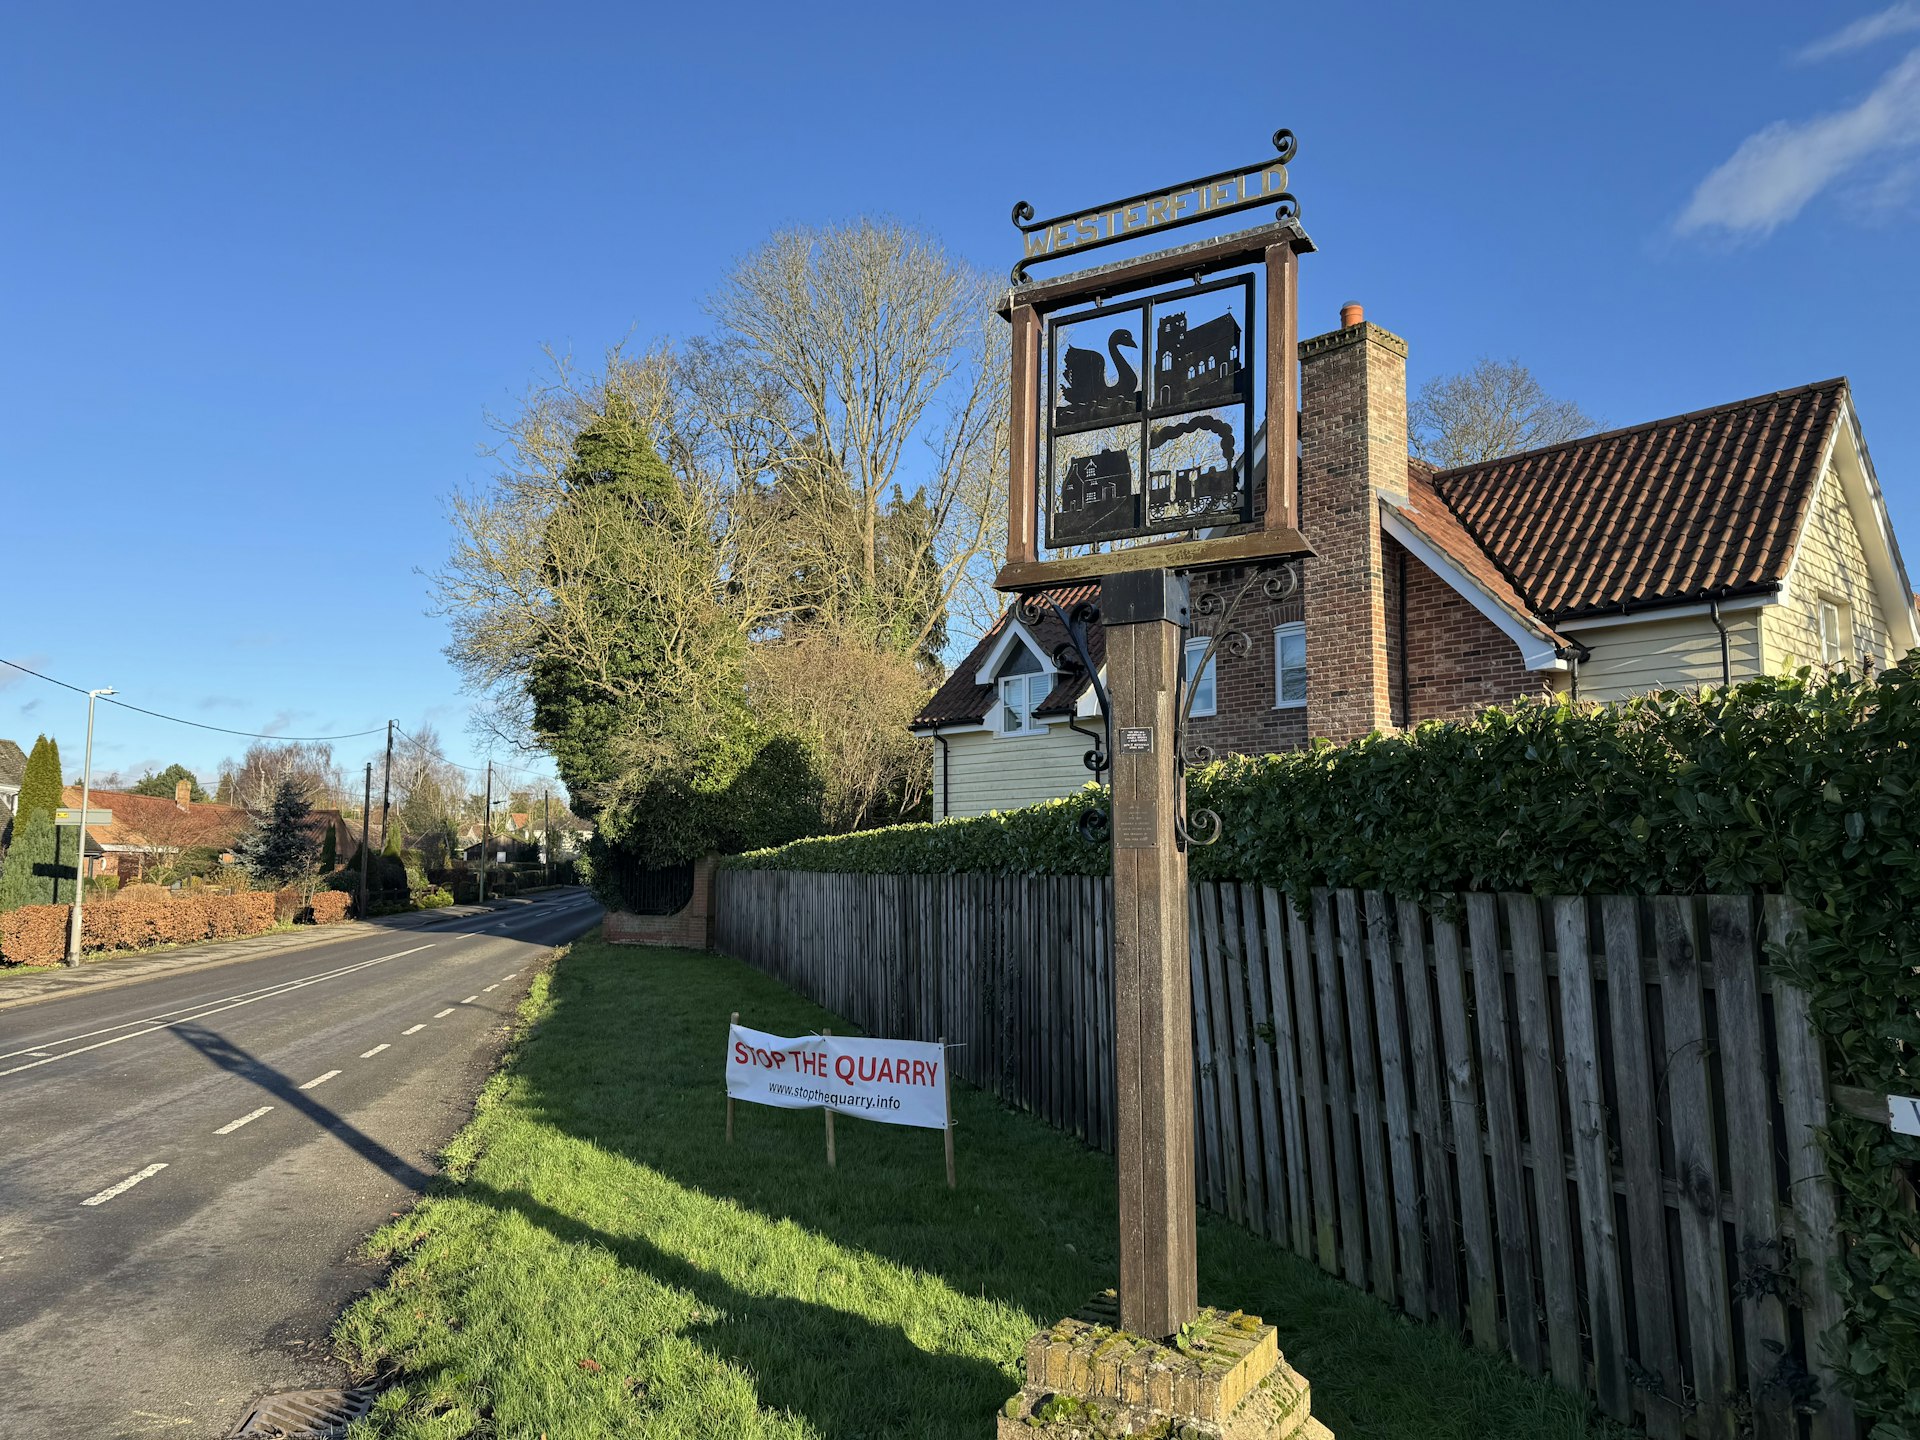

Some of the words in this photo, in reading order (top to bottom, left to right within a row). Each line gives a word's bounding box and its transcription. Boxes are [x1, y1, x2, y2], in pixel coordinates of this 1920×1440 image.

[1022, 163, 1289, 258] WESTERFIELD
[735, 1041, 786, 1069] STOP
[788, 1050, 828, 1078] THE
[834, 1055, 938, 1087] QUARRY
[768, 1082, 901, 1110] www.stopthequarry.info
